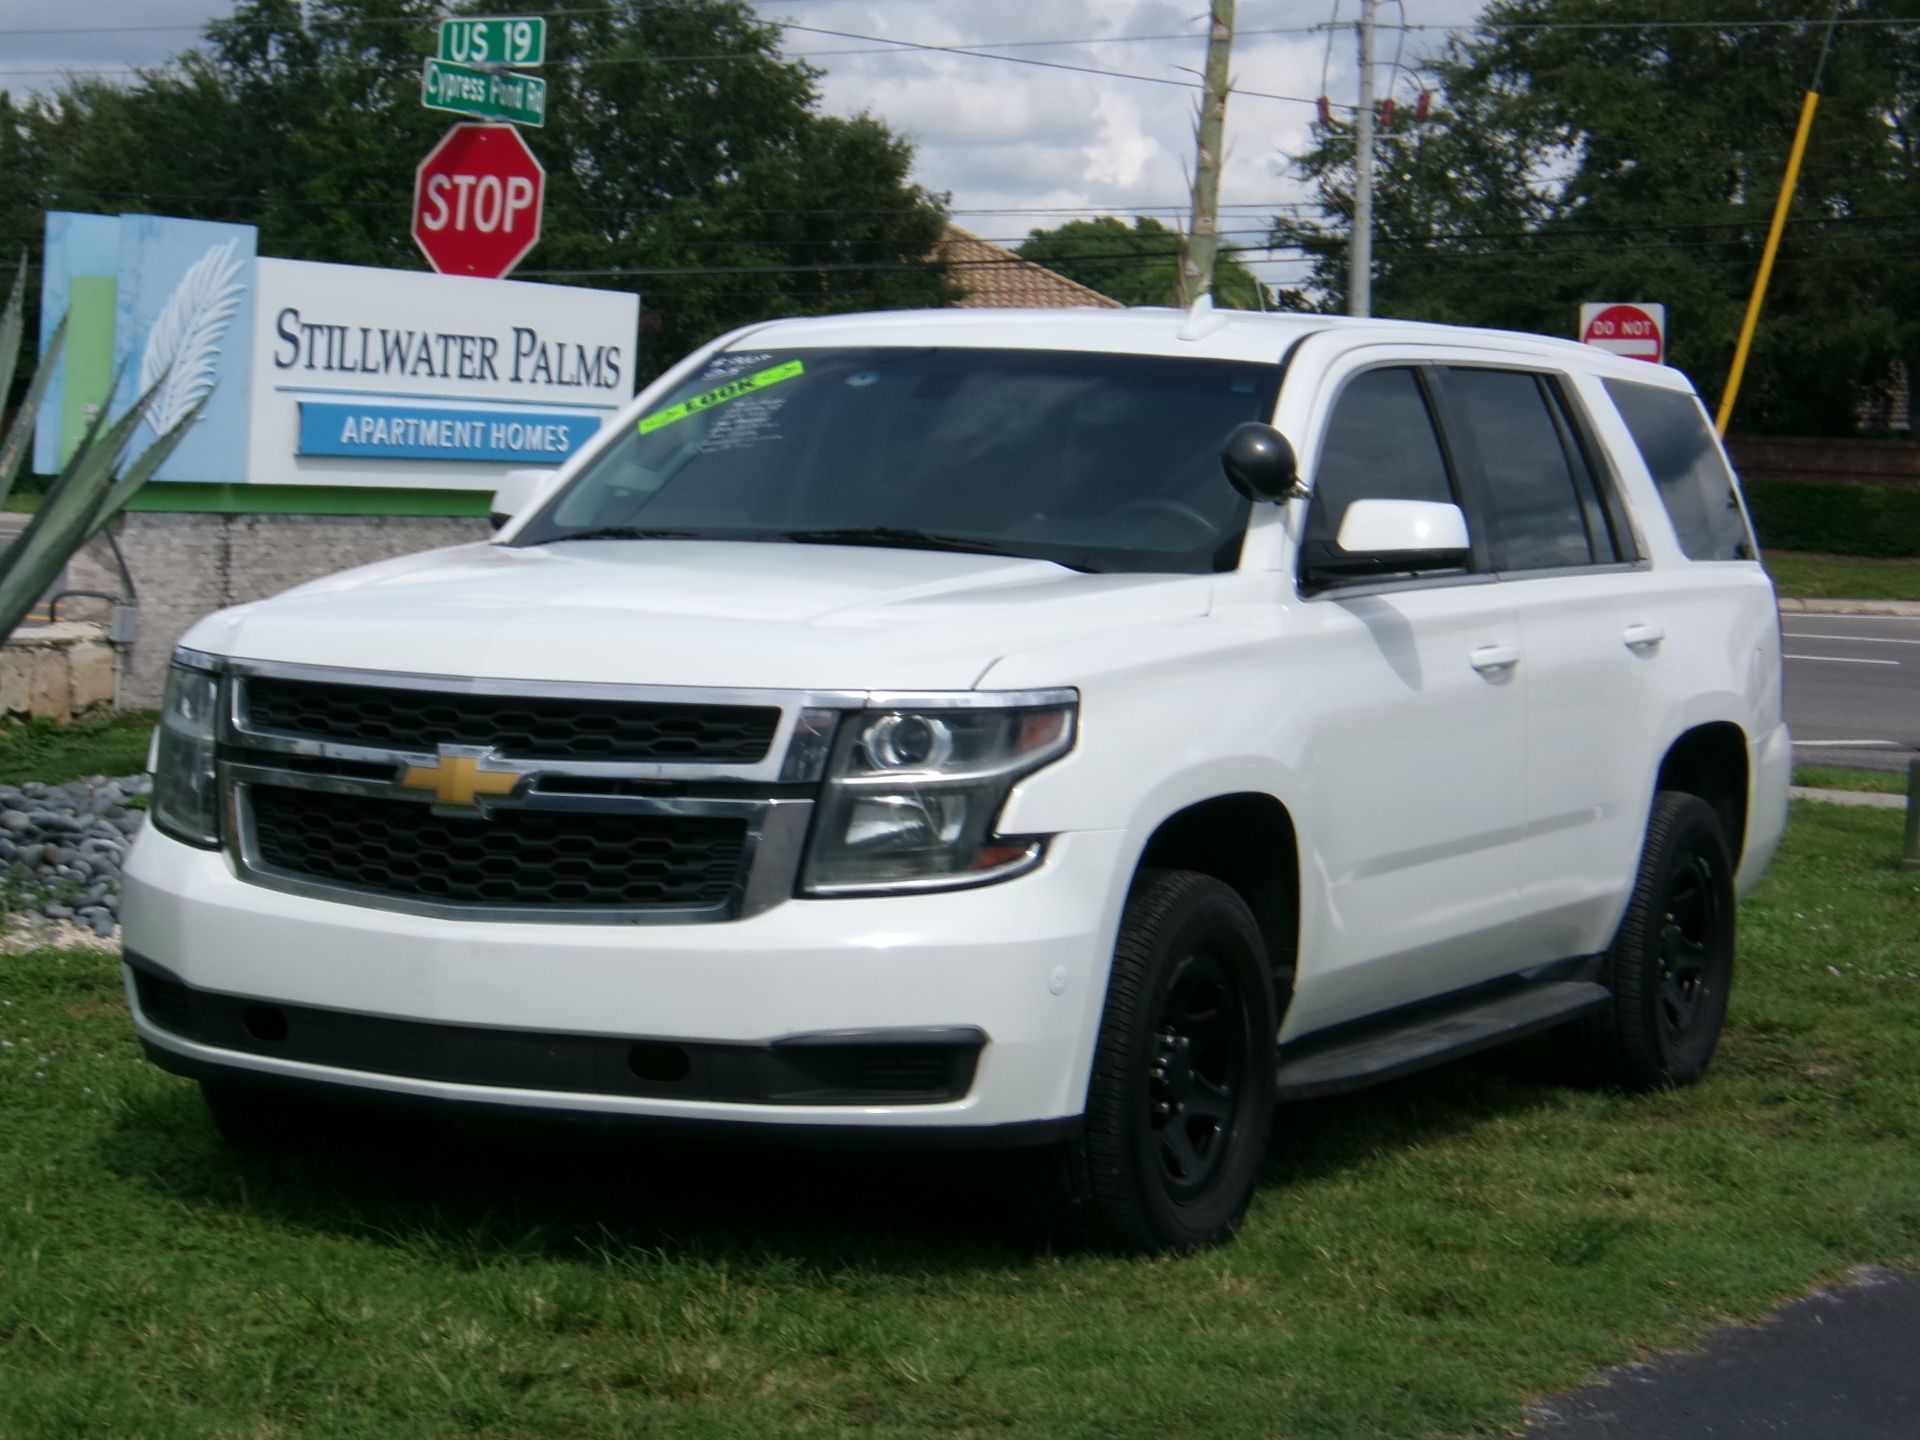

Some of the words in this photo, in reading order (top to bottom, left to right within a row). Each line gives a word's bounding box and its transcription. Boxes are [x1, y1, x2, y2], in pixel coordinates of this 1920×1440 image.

[450, 22, 488, 62] US
[503, 21, 533, 62] 19
[427, 63, 486, 105] Cypress
[489, 74, 523, 110] Pond
[526, 80, 545, 114] Rd
[422, 173, 534, 233] STOP
[274, 307, 499, 382] STILLWATER
[510, 326, 622, 389] PALMS
[1592, 321, 1616, 336] DO
[1621, 321, 1652, 336] NOT
[340, 415, 486, 450] APARTMENT
[491, 422, 570, 452] HOMES
